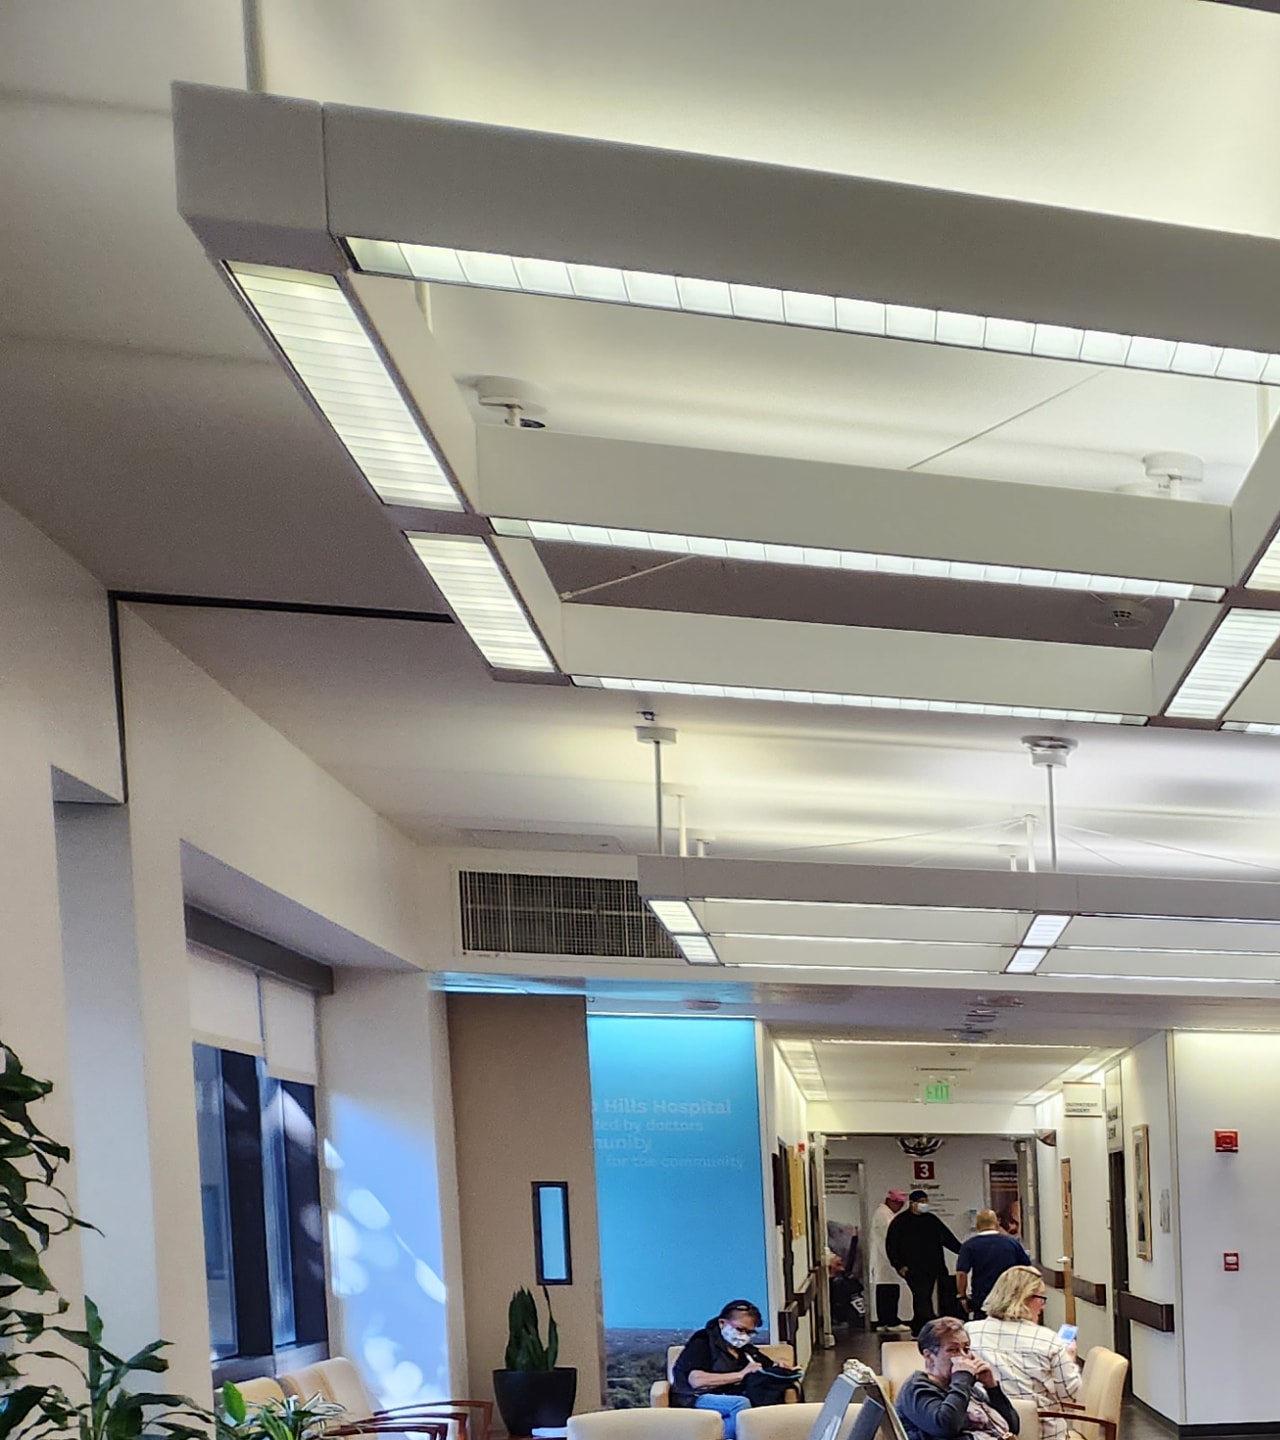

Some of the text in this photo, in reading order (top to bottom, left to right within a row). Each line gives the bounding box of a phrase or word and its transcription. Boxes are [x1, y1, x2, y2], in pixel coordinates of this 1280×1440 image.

[926, 1085, 949, 1099] EXIT
[605, 1098, 648, 1114] Hills
[653, 1099, 731, 1117] Hospital
[920, 1163, 930, 1177] 3
